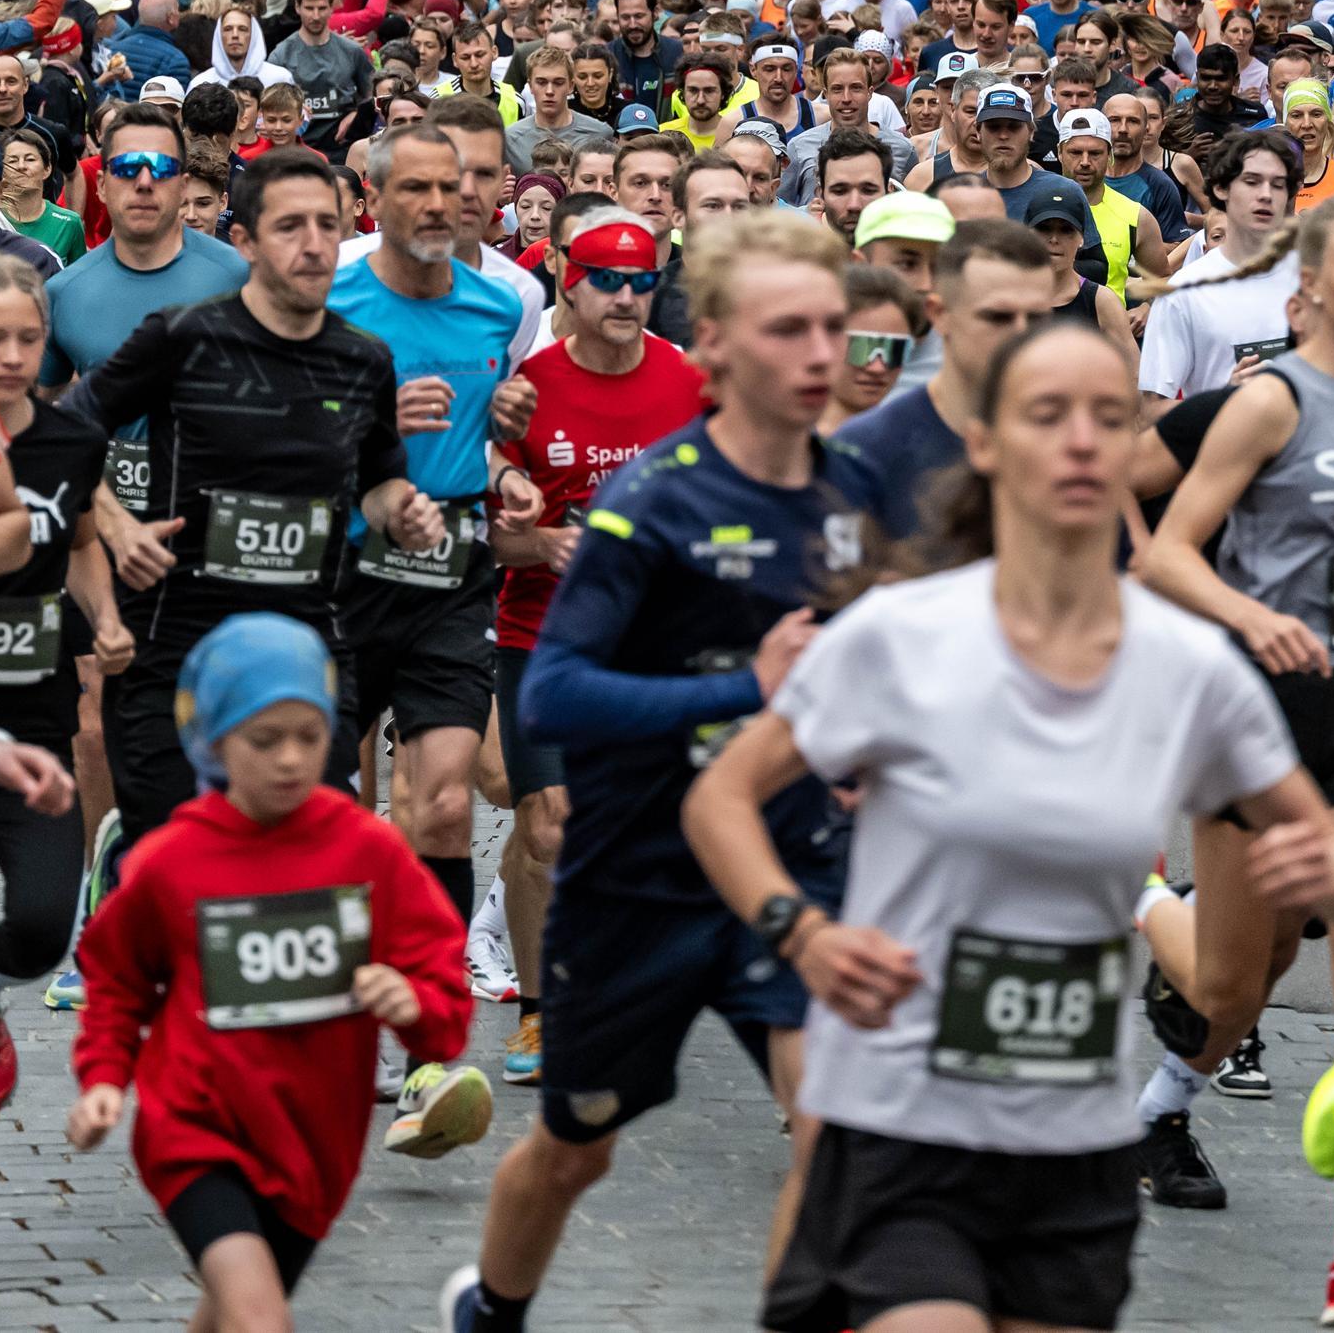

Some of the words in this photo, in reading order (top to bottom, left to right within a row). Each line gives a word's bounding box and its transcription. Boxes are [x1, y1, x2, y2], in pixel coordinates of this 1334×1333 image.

[235, 518, 305, 556] 510
[240, 553, 294, 568] GÜNTER
[237, 924, 340, 984] 903
[985, 976, 1095, 1038] 618
